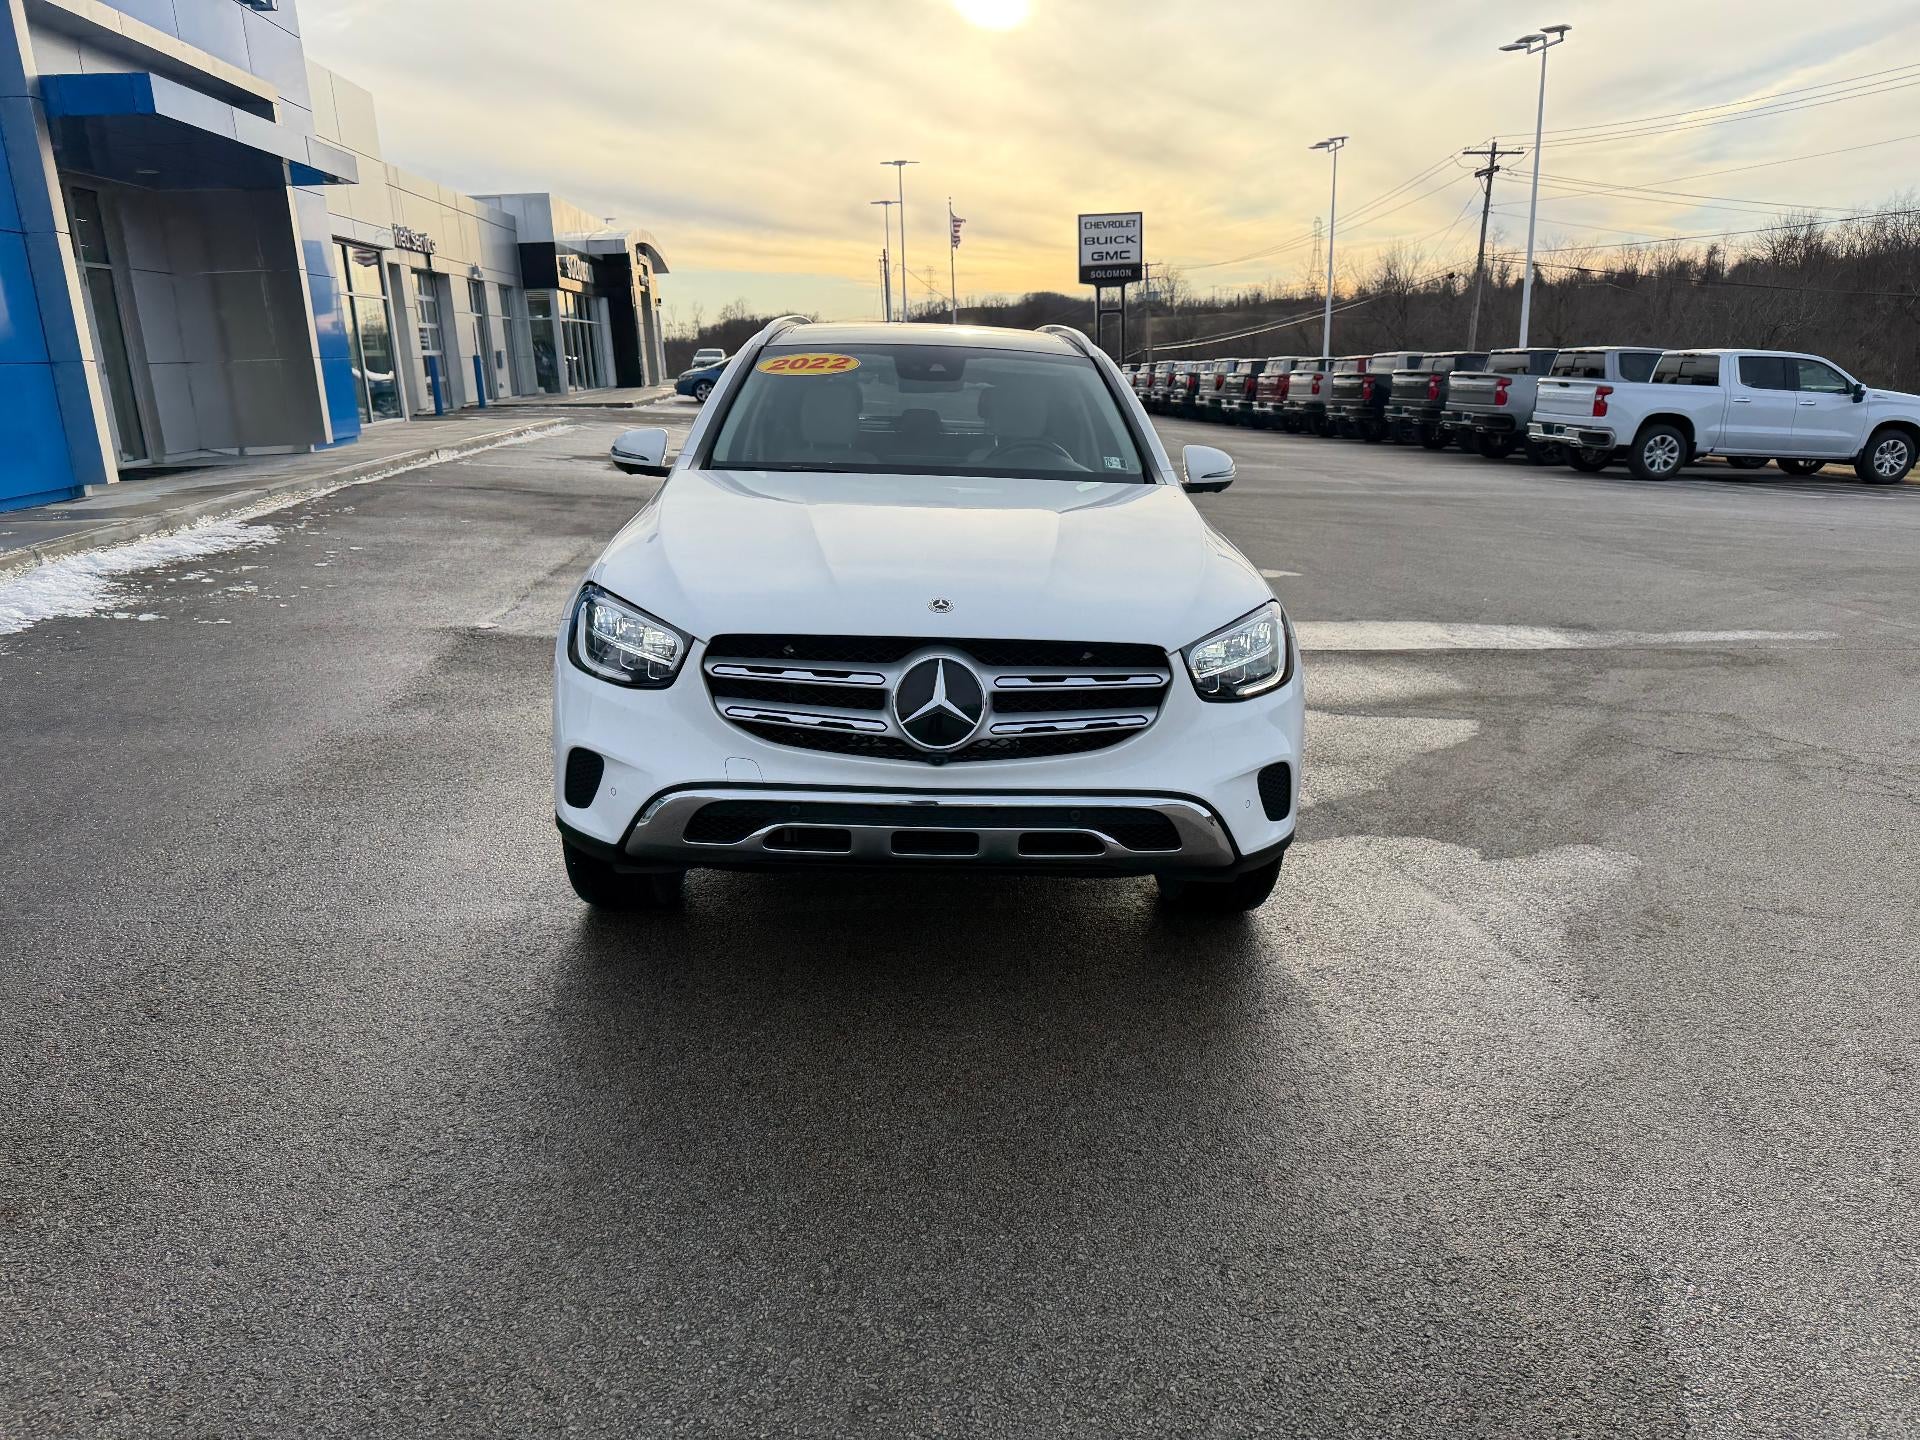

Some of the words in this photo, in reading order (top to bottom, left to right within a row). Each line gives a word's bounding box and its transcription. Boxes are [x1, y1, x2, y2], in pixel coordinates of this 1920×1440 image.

[1084, 220, 1137, 229] CHEVROLET
[1084, 234, 1137, 246] BUICK
[1091, 250, 1131, 261] GMC
[1090, 269, 1132, 279] SOLOMON
[766, 357, 851, 371] 2022
